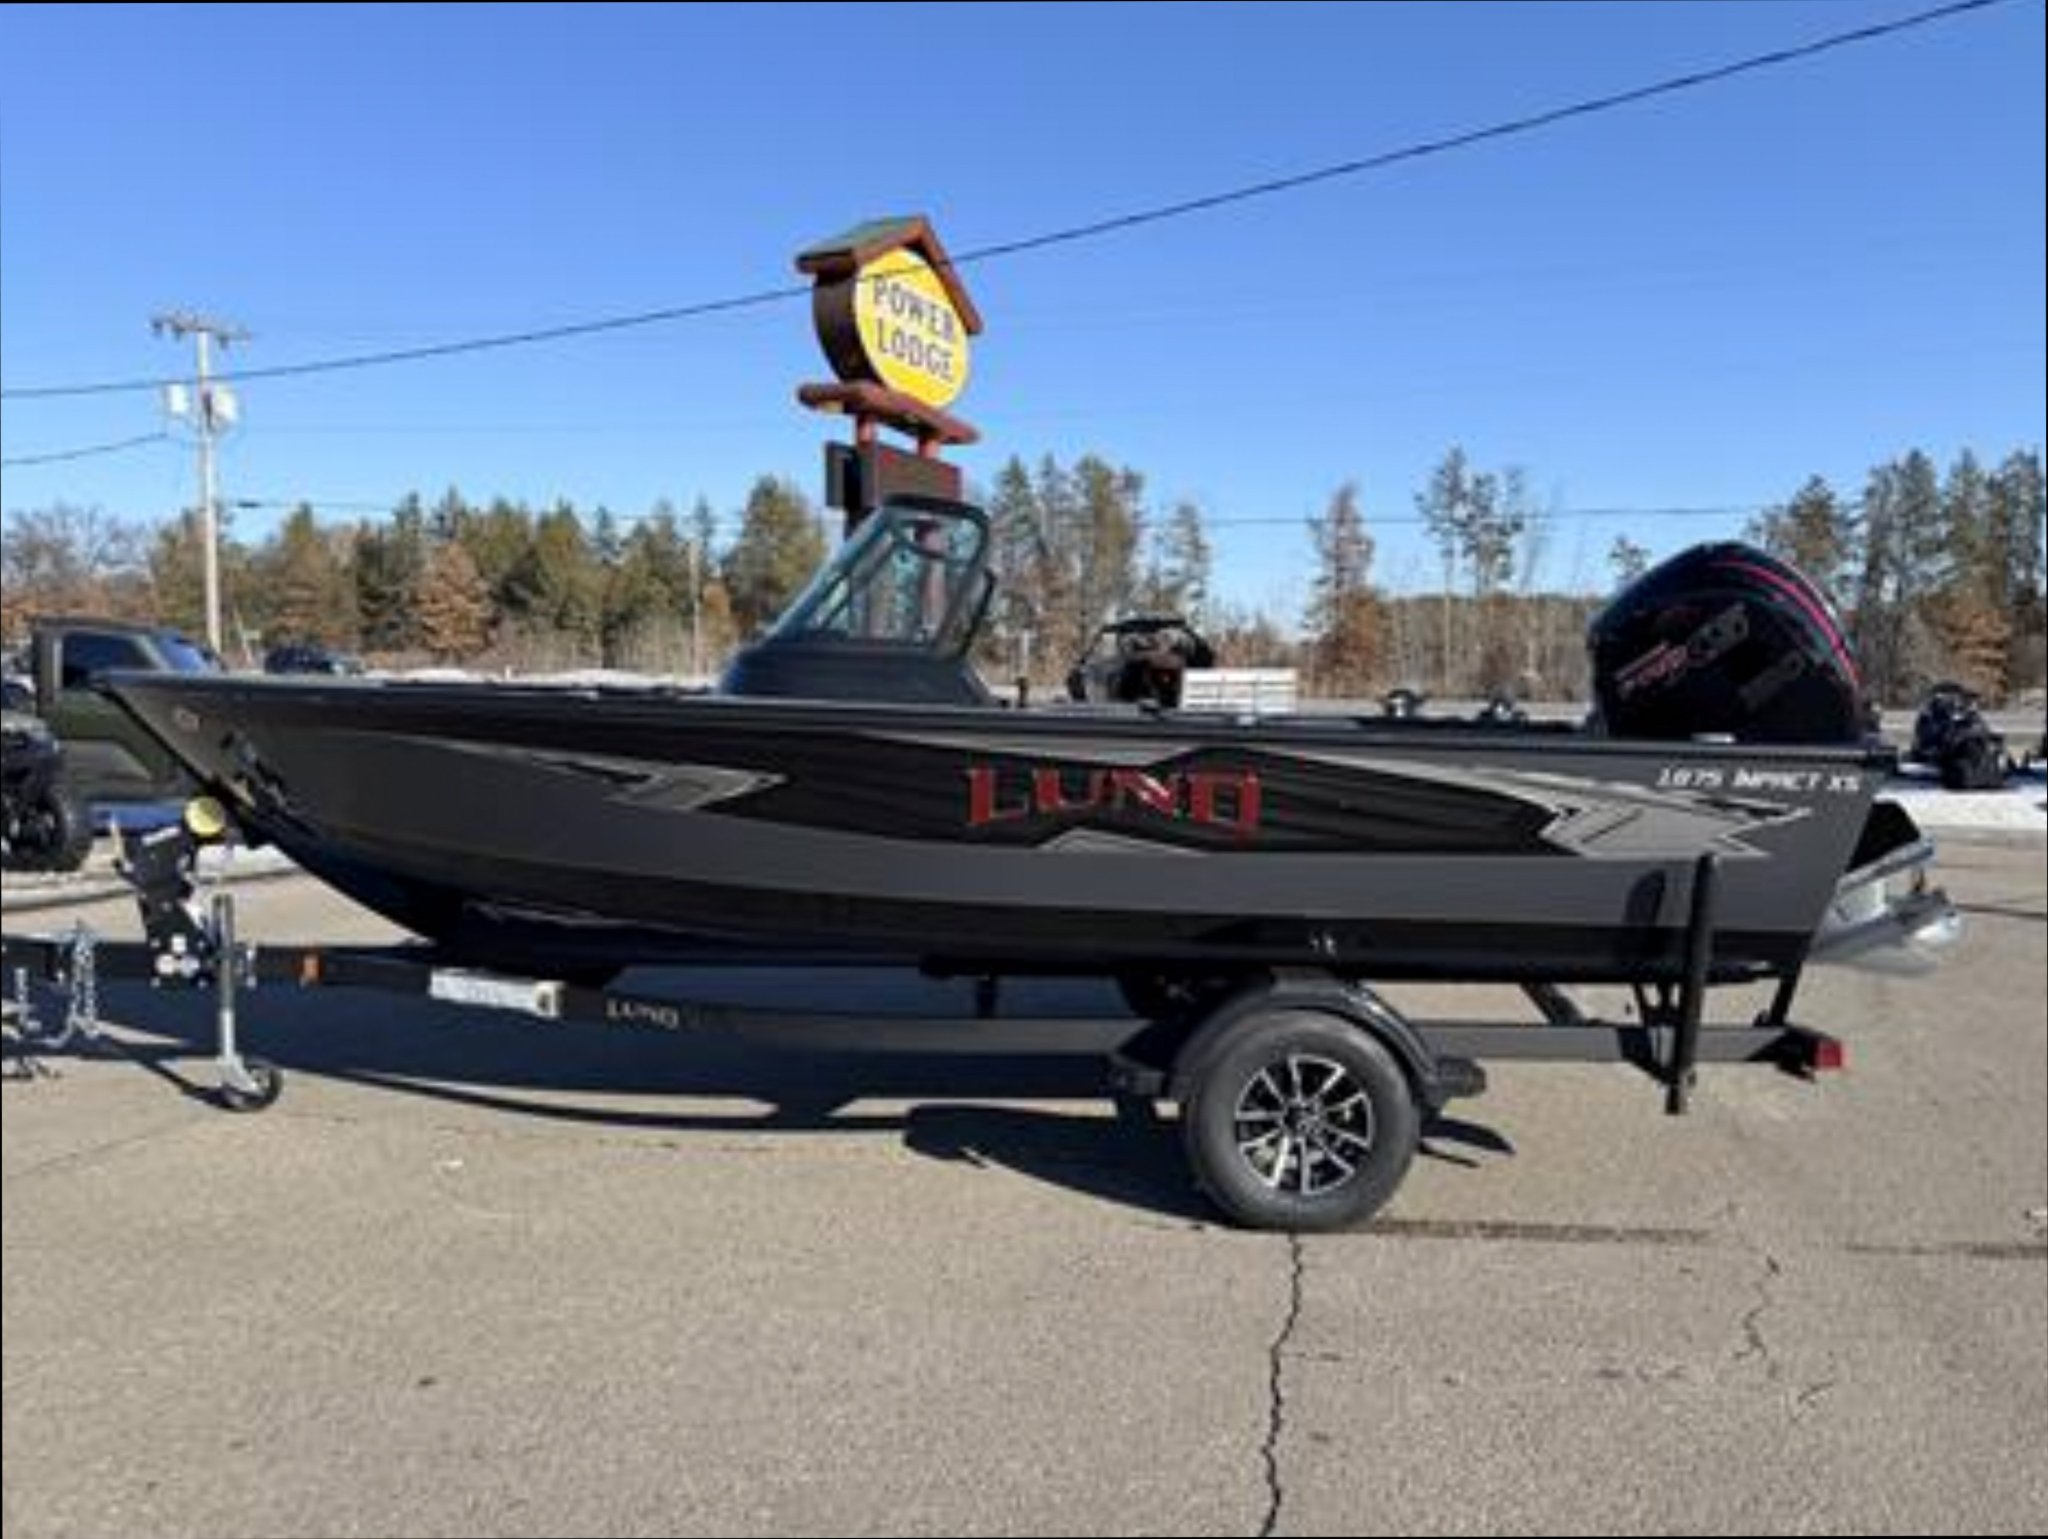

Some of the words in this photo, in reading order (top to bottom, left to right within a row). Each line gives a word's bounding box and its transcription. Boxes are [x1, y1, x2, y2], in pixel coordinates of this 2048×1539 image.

[873, 275, 954, 343] POWER
[876, 318, 953, 379] LODGE
[966, 763, 1261, 836] LUND
[606, 998, 679, 1029] LUND
